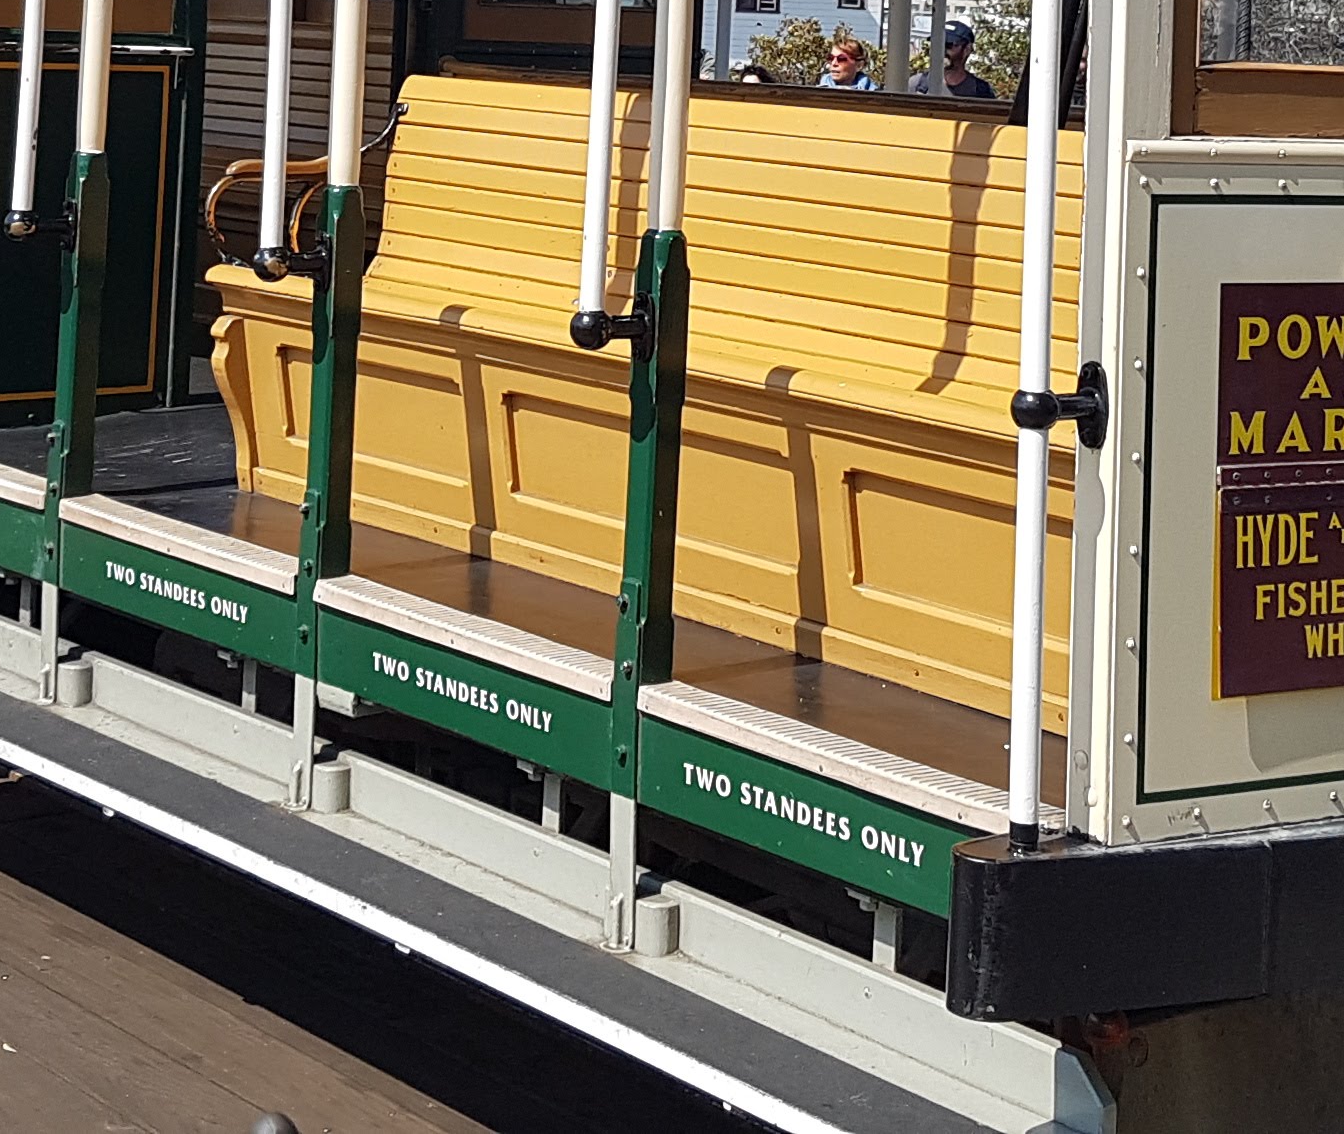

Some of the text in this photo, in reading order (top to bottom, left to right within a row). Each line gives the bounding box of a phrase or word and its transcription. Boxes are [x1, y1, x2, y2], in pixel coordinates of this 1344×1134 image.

[1235, 510, 1319, 569] HYDE
[105, 560, 249, 625] TWO STANDEES ONLY
[372, 651, 553, 733] TWO STANDEES ONLY
[682, 762, 927, 868] TWO STANDEES ONLY
